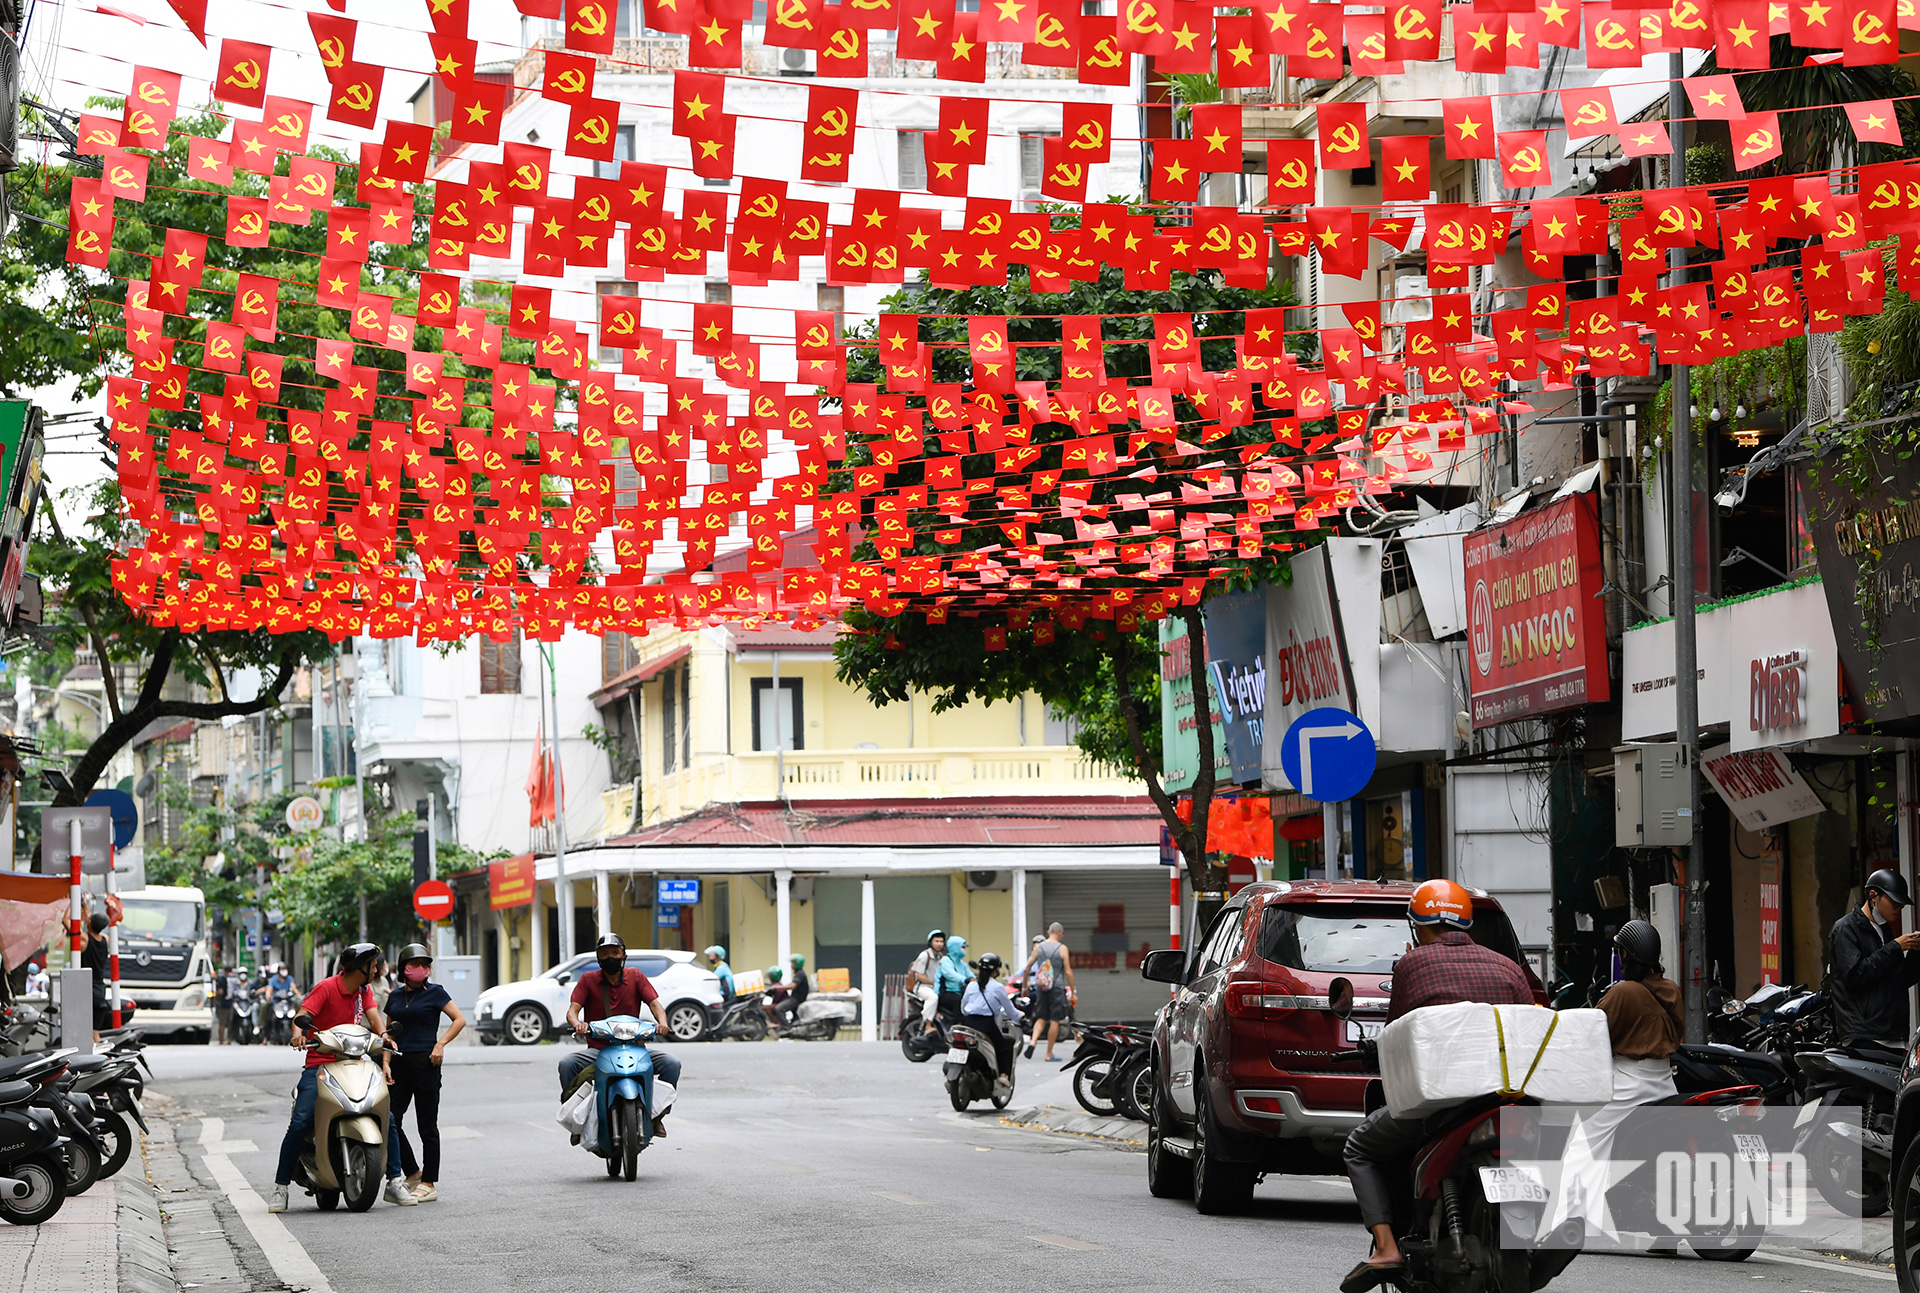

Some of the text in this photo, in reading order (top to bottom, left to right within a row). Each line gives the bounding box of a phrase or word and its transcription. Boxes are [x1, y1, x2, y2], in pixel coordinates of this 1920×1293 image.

[1466, 545, 1481, 568] CÔNG
[1481, 544, 1488, 562] TY
[1557, 512, 1575, 536] NGỌC
[1515, 562, 1531, 603] HỎI
[1533, 561, 1558, 602] TRỌN
[1560, 548, 1578, 588] GÓI
[1500, 605, 1576, 668] AN NGỌC
[1770, 654, 1784, 668] Coffee
[1750, 656, 1800, 732] EMBER
[1476, 700, 1484, 720] 66
[1436, 900, 1464, 910] Ahamove
[1760, 884, 1778, 910] PHOTO
[1762, 920, 1778, 944] COPY
[1738, 1135, 1762, 1148] 29-C1
[1488, 1184, 1542, 1200] 057.96
